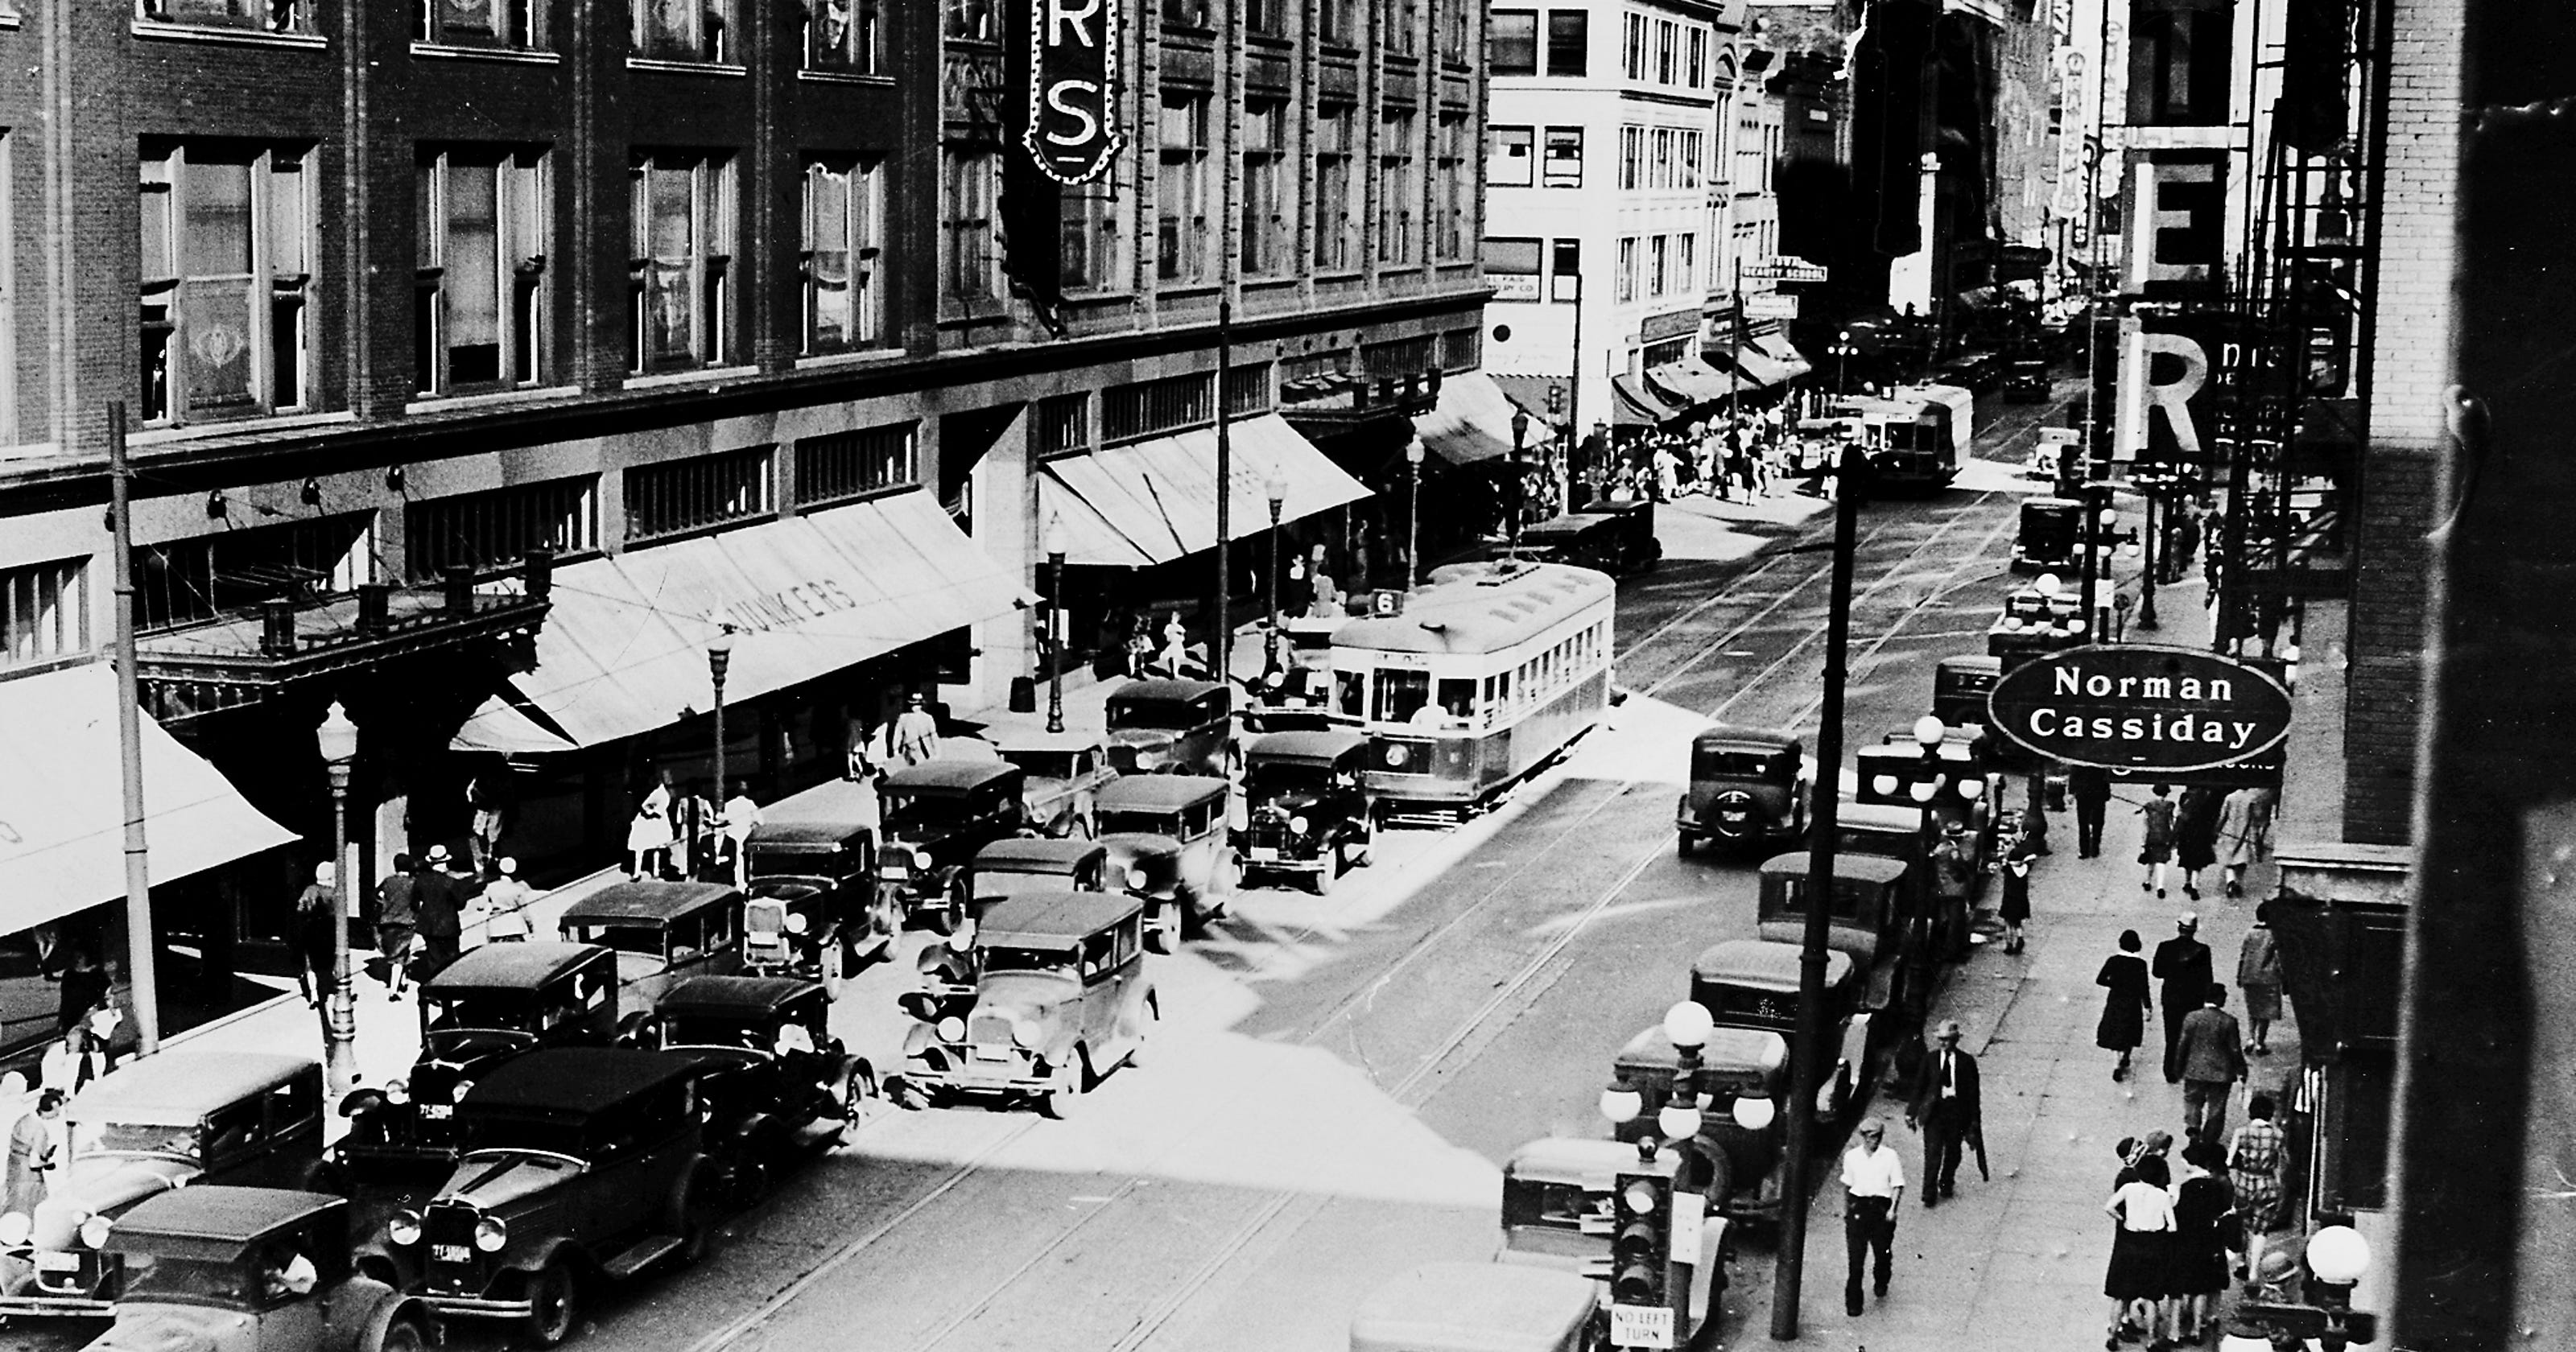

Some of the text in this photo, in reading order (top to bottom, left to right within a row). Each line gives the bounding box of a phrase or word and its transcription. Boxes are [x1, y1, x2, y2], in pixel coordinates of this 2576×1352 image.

[1744, 267, 1823, 278] BEAUTY SCHOOL
[1377, 592, 1393, 613] 6
[2054, 666, 2232, 702] Norman
[2029, 708, 2257, 749] Cassiday
[1616, 1312, 1667, 1325] NO LEFT
[1626, 1327, 1659, 1341] TURN
